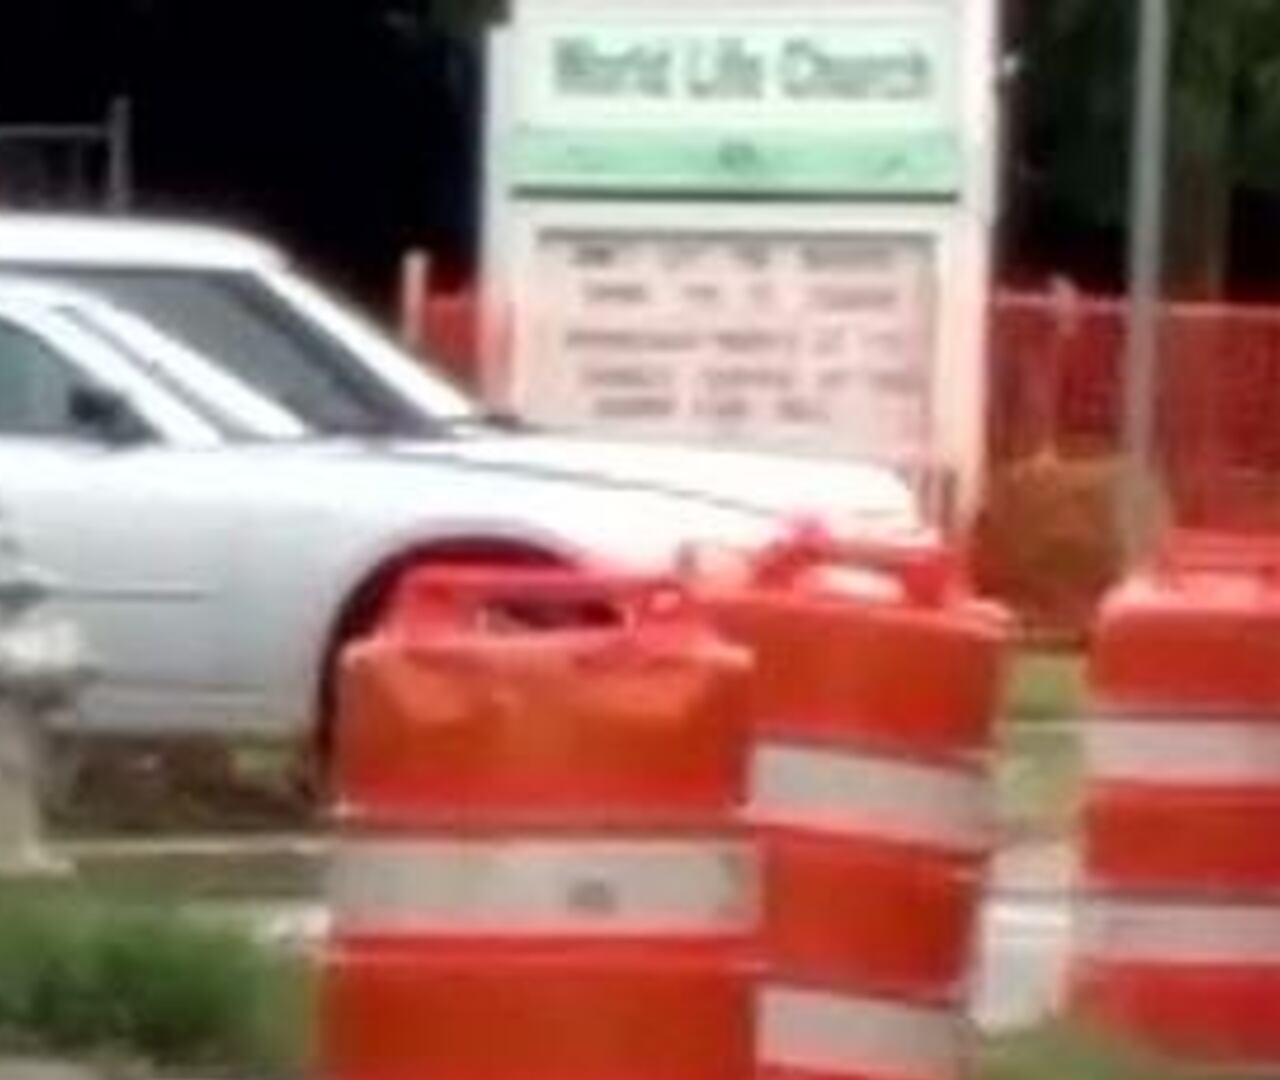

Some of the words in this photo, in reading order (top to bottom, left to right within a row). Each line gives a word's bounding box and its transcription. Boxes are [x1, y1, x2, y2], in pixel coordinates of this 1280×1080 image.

[554, 36, 671, 97] World
[686, 36, 764, 98] Life
[780, 36, 932, 100] Church
